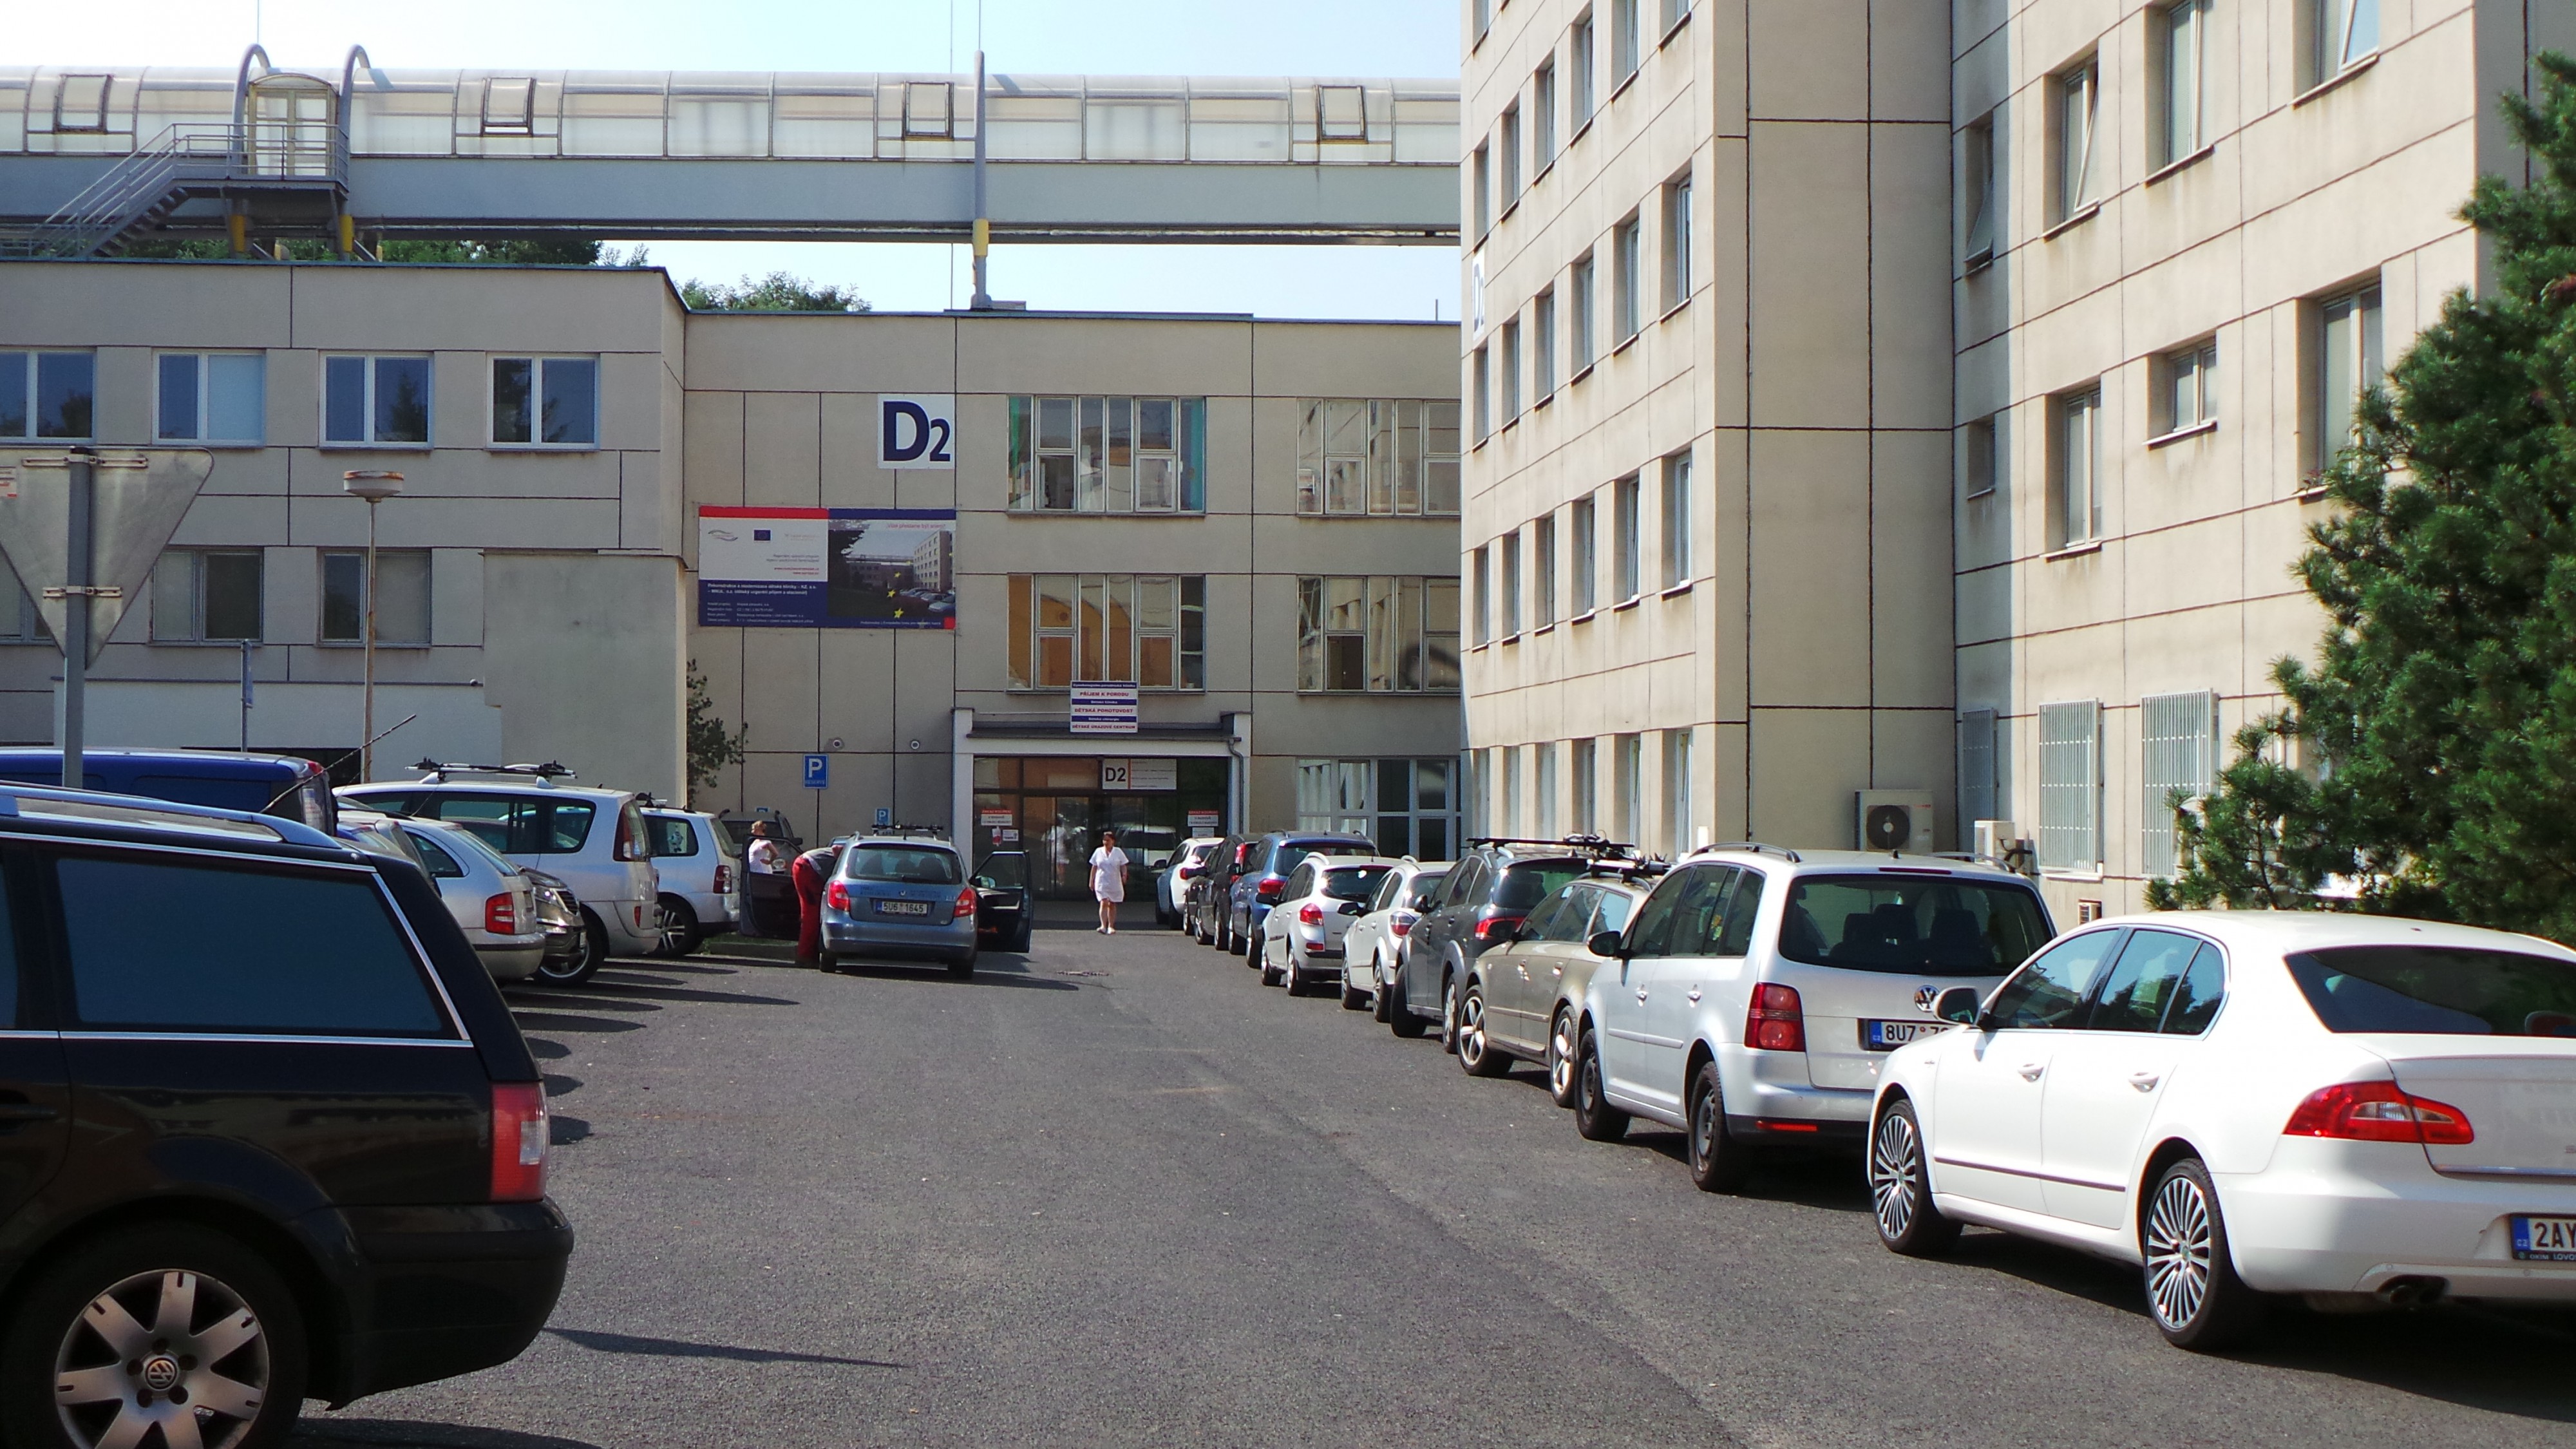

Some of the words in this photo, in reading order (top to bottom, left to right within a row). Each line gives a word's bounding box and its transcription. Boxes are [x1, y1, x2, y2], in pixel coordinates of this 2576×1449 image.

[883, 401, 951, 462] D2
[808, 758, 822, 778] P
[1105, 767, 1126, 782] D2
[878, 810, 886, 820] P
[884, 902, 898, 911] 5U6
[905, 904, 923, 913] 1645
[1886, 1025, 1916, 1041] 8U7
[2534, 1222, 2576, 1248] 2AY
